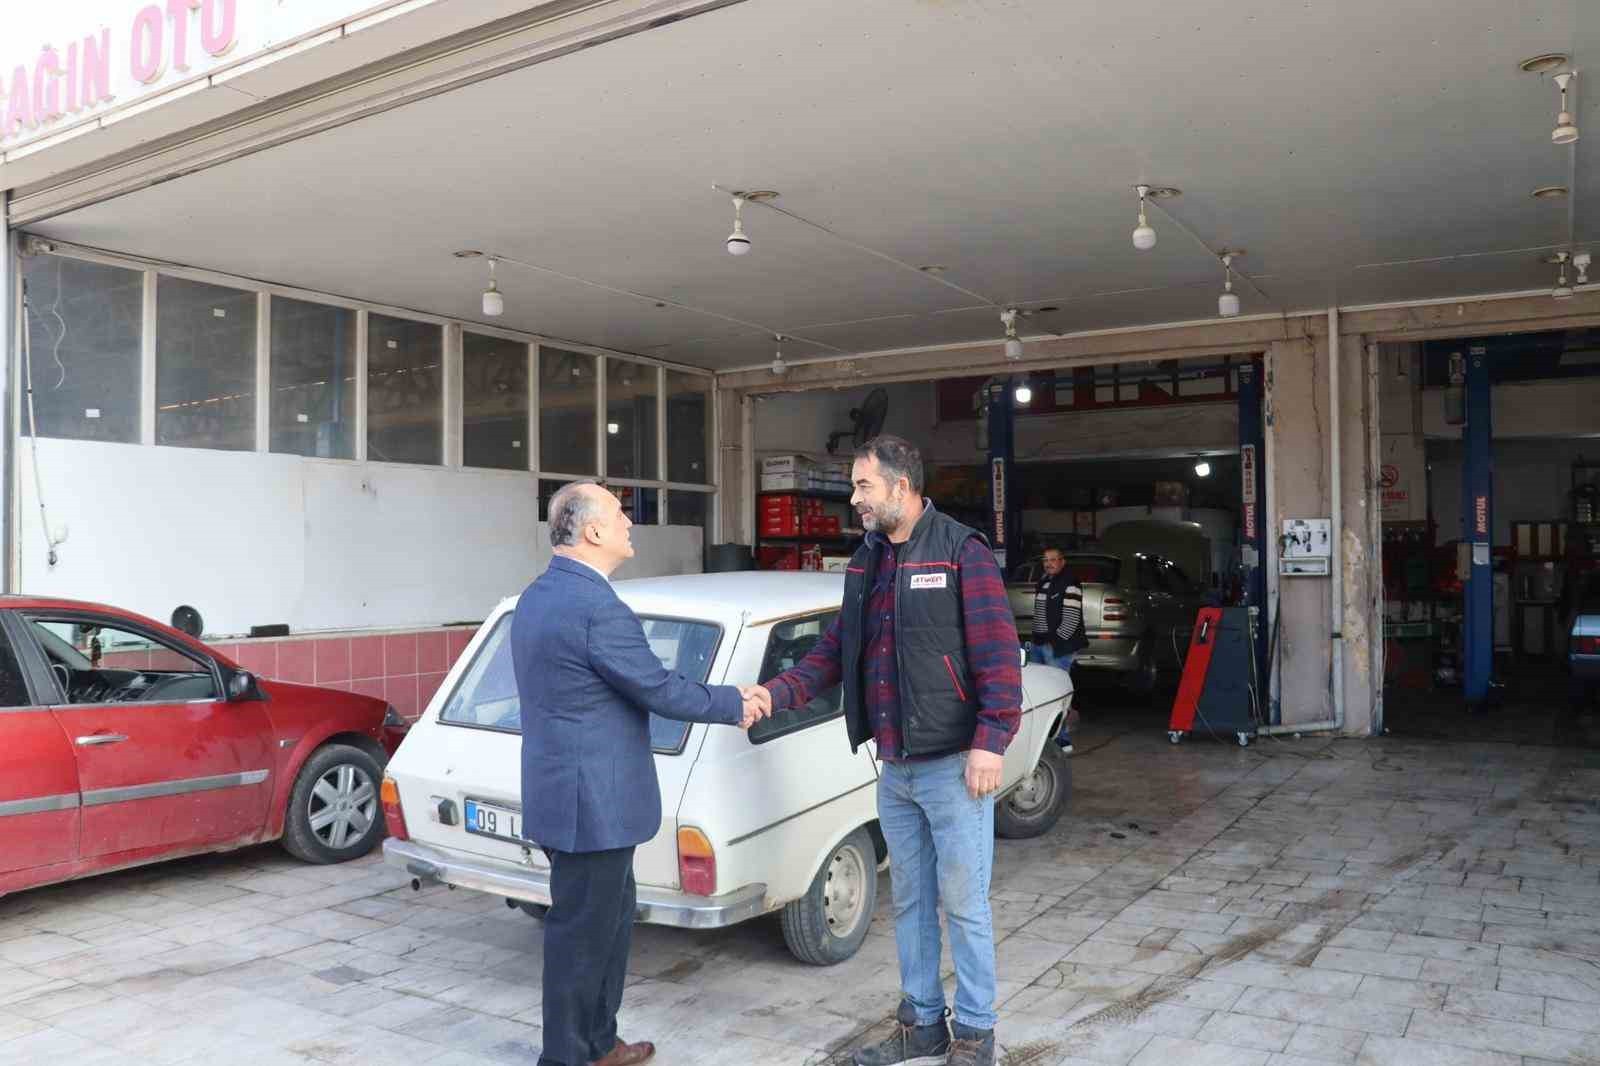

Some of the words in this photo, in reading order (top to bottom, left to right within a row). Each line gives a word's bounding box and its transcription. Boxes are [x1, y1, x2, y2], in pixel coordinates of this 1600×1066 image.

[1245, 504, 1255, 538] MOTUL
[1476, 497, 1486, 533] MOTUL
[477, 808, 496, 832] 09
